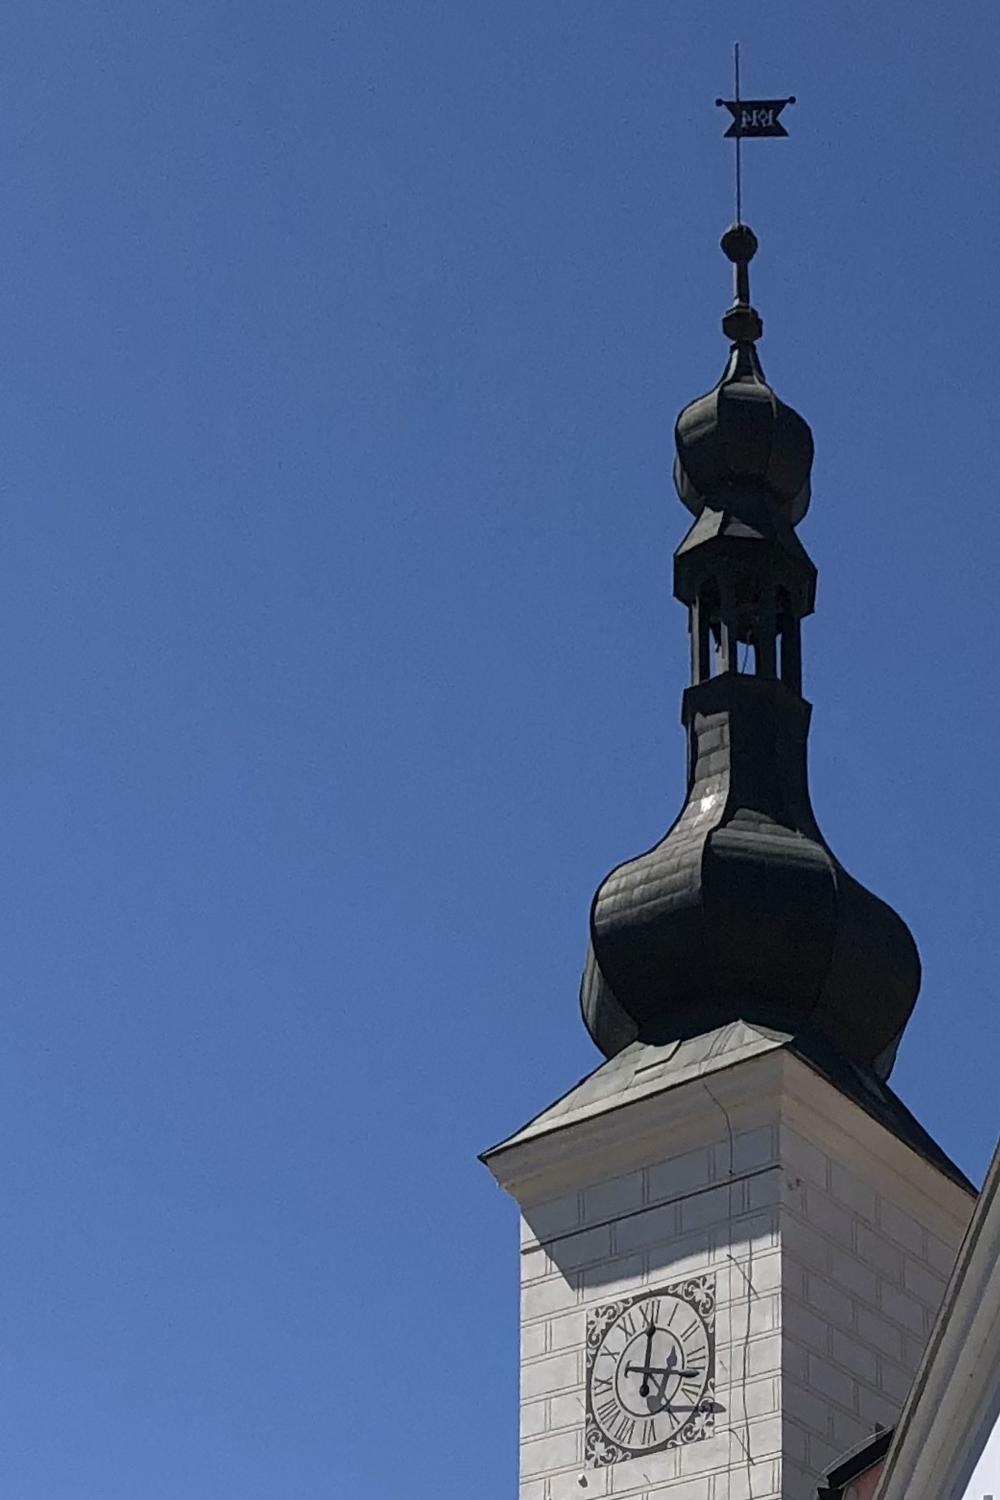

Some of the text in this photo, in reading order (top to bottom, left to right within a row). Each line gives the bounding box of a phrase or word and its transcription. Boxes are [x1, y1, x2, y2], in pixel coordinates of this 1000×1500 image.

[616, 1311, 637, 1342] XI
[667, 1302, 679, 1327] I
[680, 1319, 700, 1342] II
[600, 1344, 620, 1363] X
[686, 1345, 706, 1370] III
[594, 1375, 613, 1396] IX
[681, 1382, 702, 1404] IV
[597, 1398, 621, 1430] VIII
[613, 1416, 636, 1445] VII
[641, 1417, 656, 1445] VI
